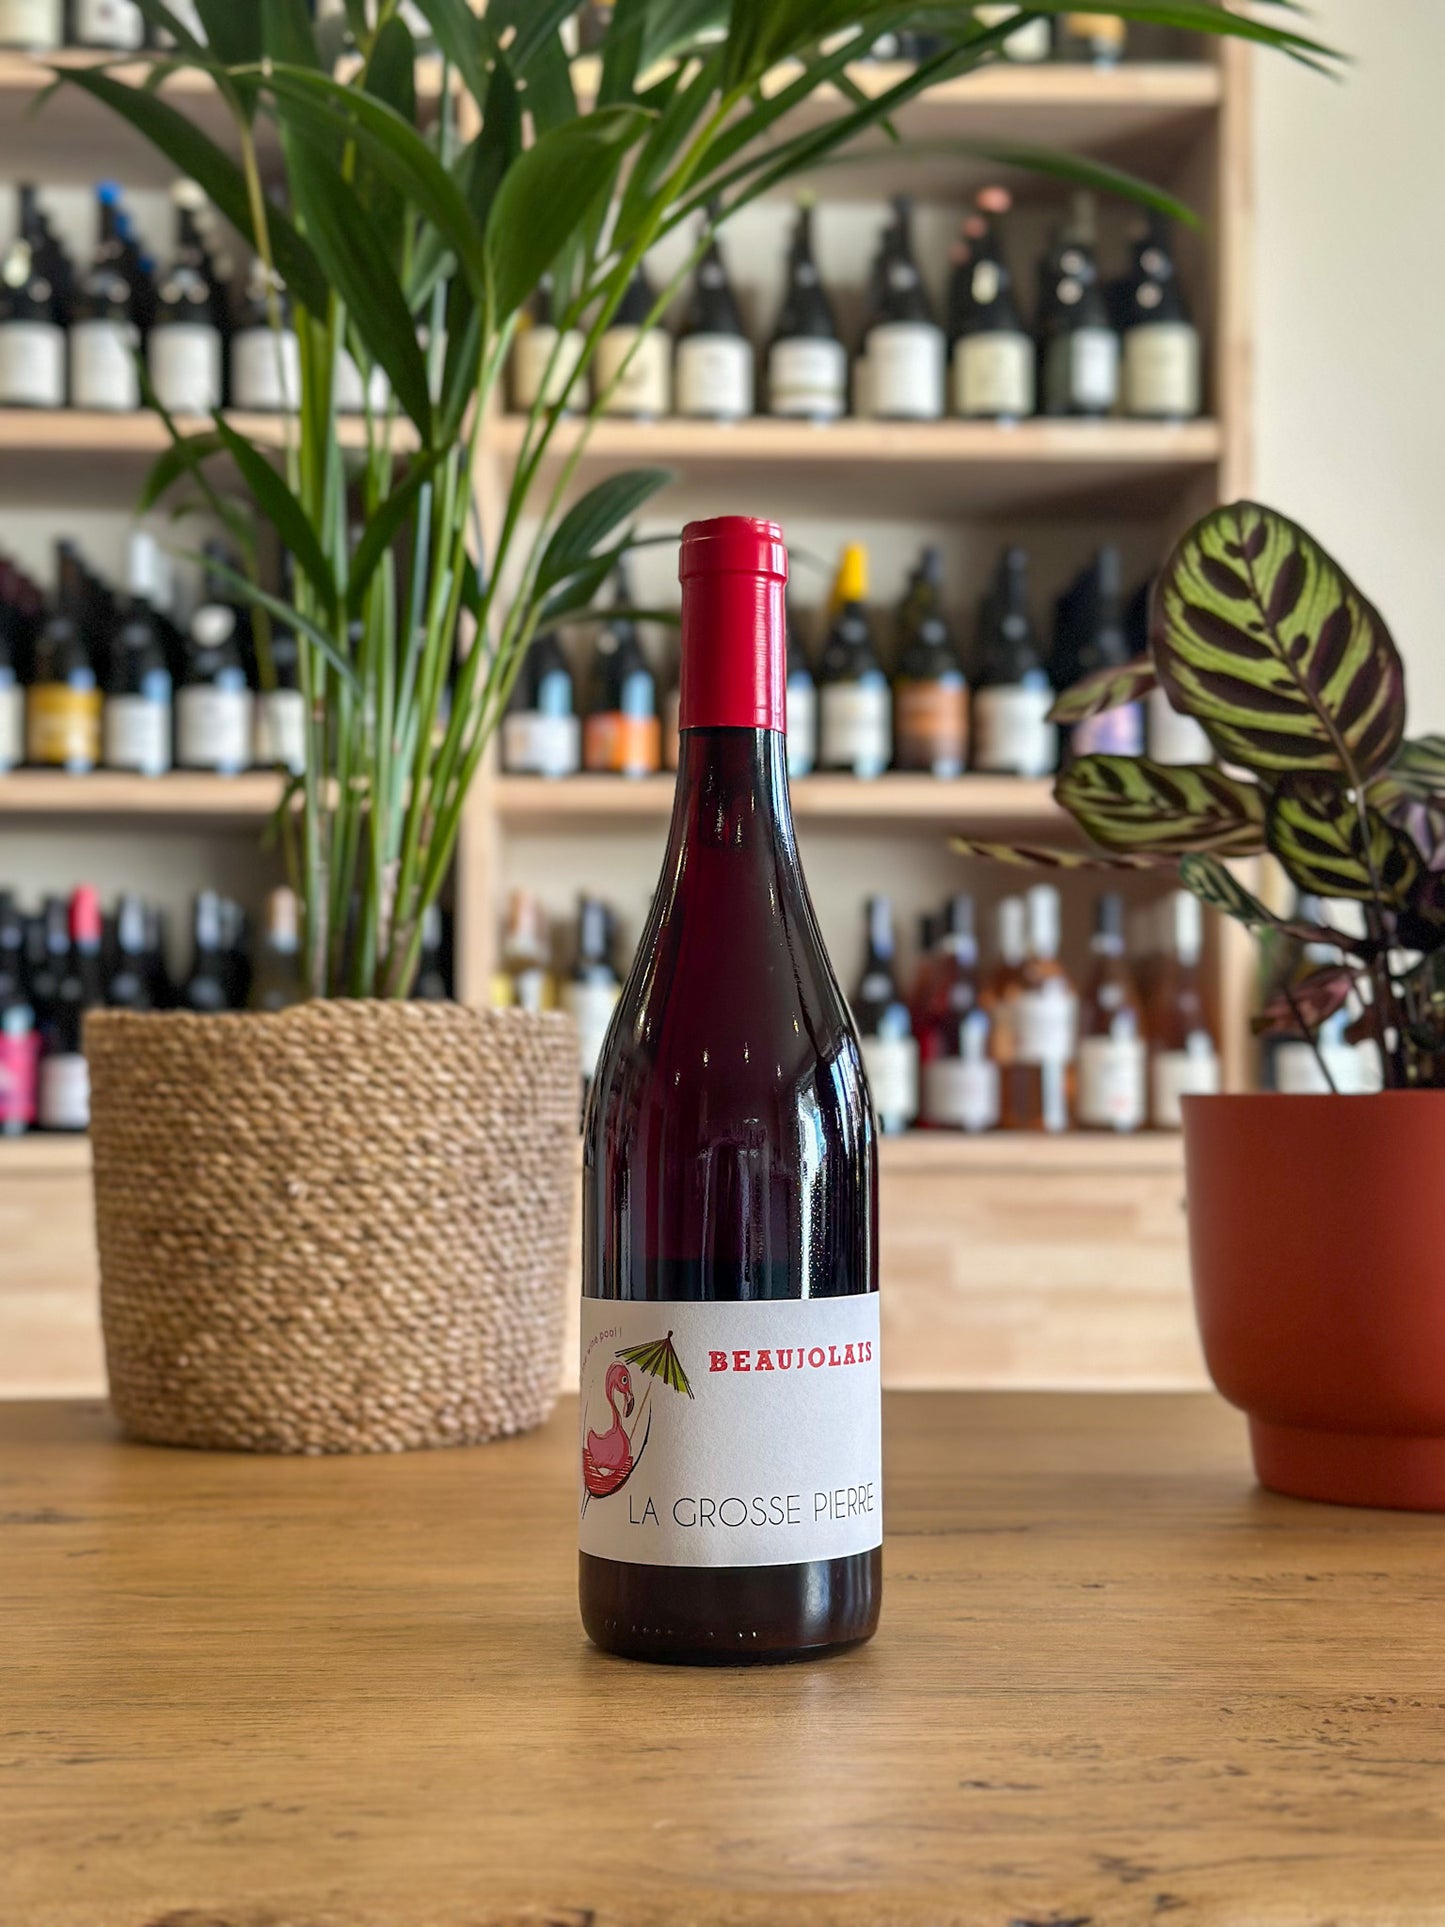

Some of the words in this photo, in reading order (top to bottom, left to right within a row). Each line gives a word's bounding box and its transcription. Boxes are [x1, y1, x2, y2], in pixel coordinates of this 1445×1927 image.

[599, 1327, 617, 1342] pool
[708, 1341, 873, 1373] BEAUJOLAIS
[628, 1495, 660, 1526] LA
[672, 1494, 801, 1528] GROSSE
[813, 1482, 874, 1523] PIERRE
